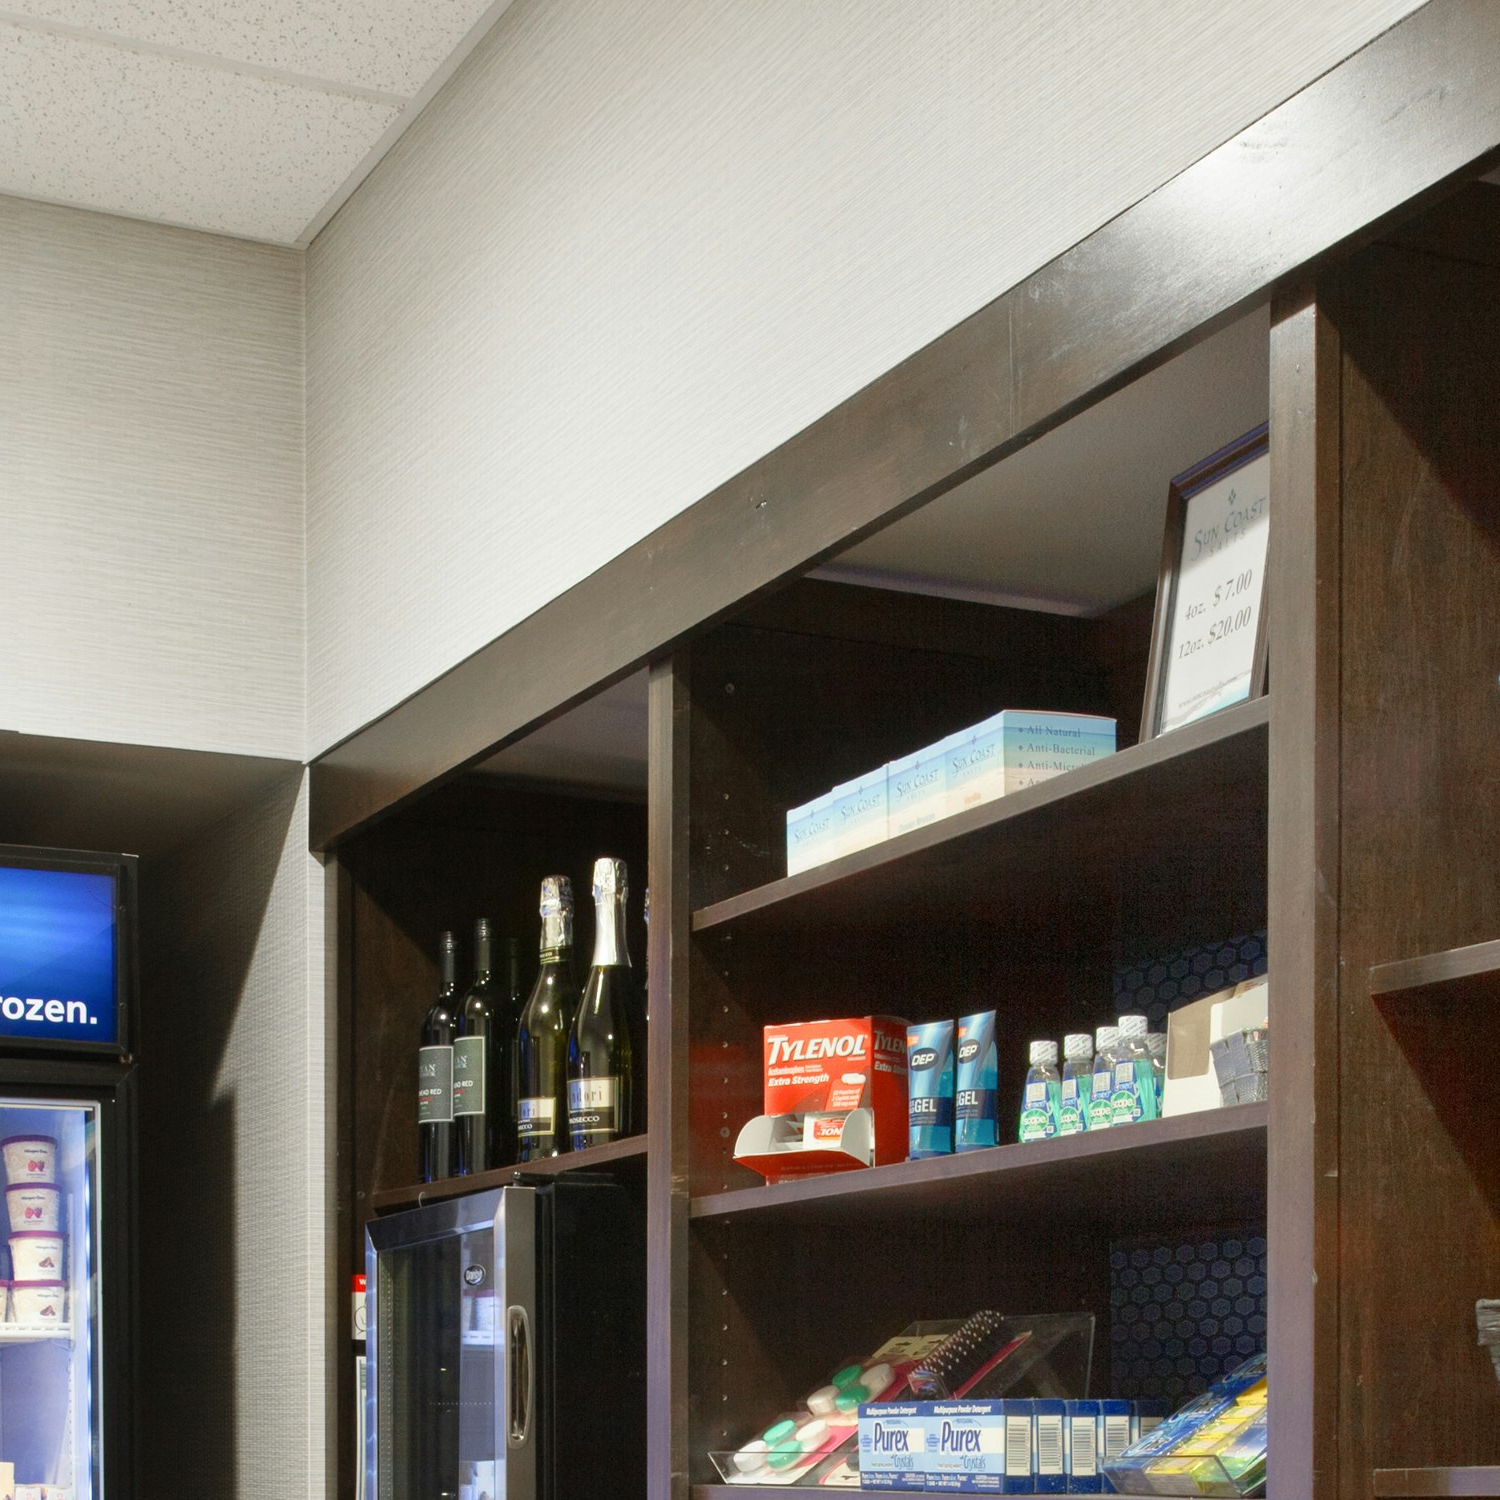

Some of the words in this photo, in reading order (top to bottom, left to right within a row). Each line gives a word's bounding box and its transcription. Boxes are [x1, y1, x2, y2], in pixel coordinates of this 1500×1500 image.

[1224, 496, 1267, 534] COAST
[1225, 568, 1253, 601] 7.00
[1208, 606, 1252, 646] $20.00
[1027, 725, 1043, 735] All
[1045, 726, 1081, 738] Natural
[1027, 743, 1095, 756] Anti-Bacterial
[766, 1034, 866, 1066] TYLENOL
[959, 1044, 978, 1057] DEP
[911, 1054, 935, 1067] DEP
[768, 1077, 791, 1087] Extra
[792, 1073, 830, 1088] Strength
[914, 1099, 937, 1113] GEL
[959, 1091, 978, 1106] GEL
[874, 1422, 909, 1452] Purex
[941, 1421, 981, 1452] Purex
